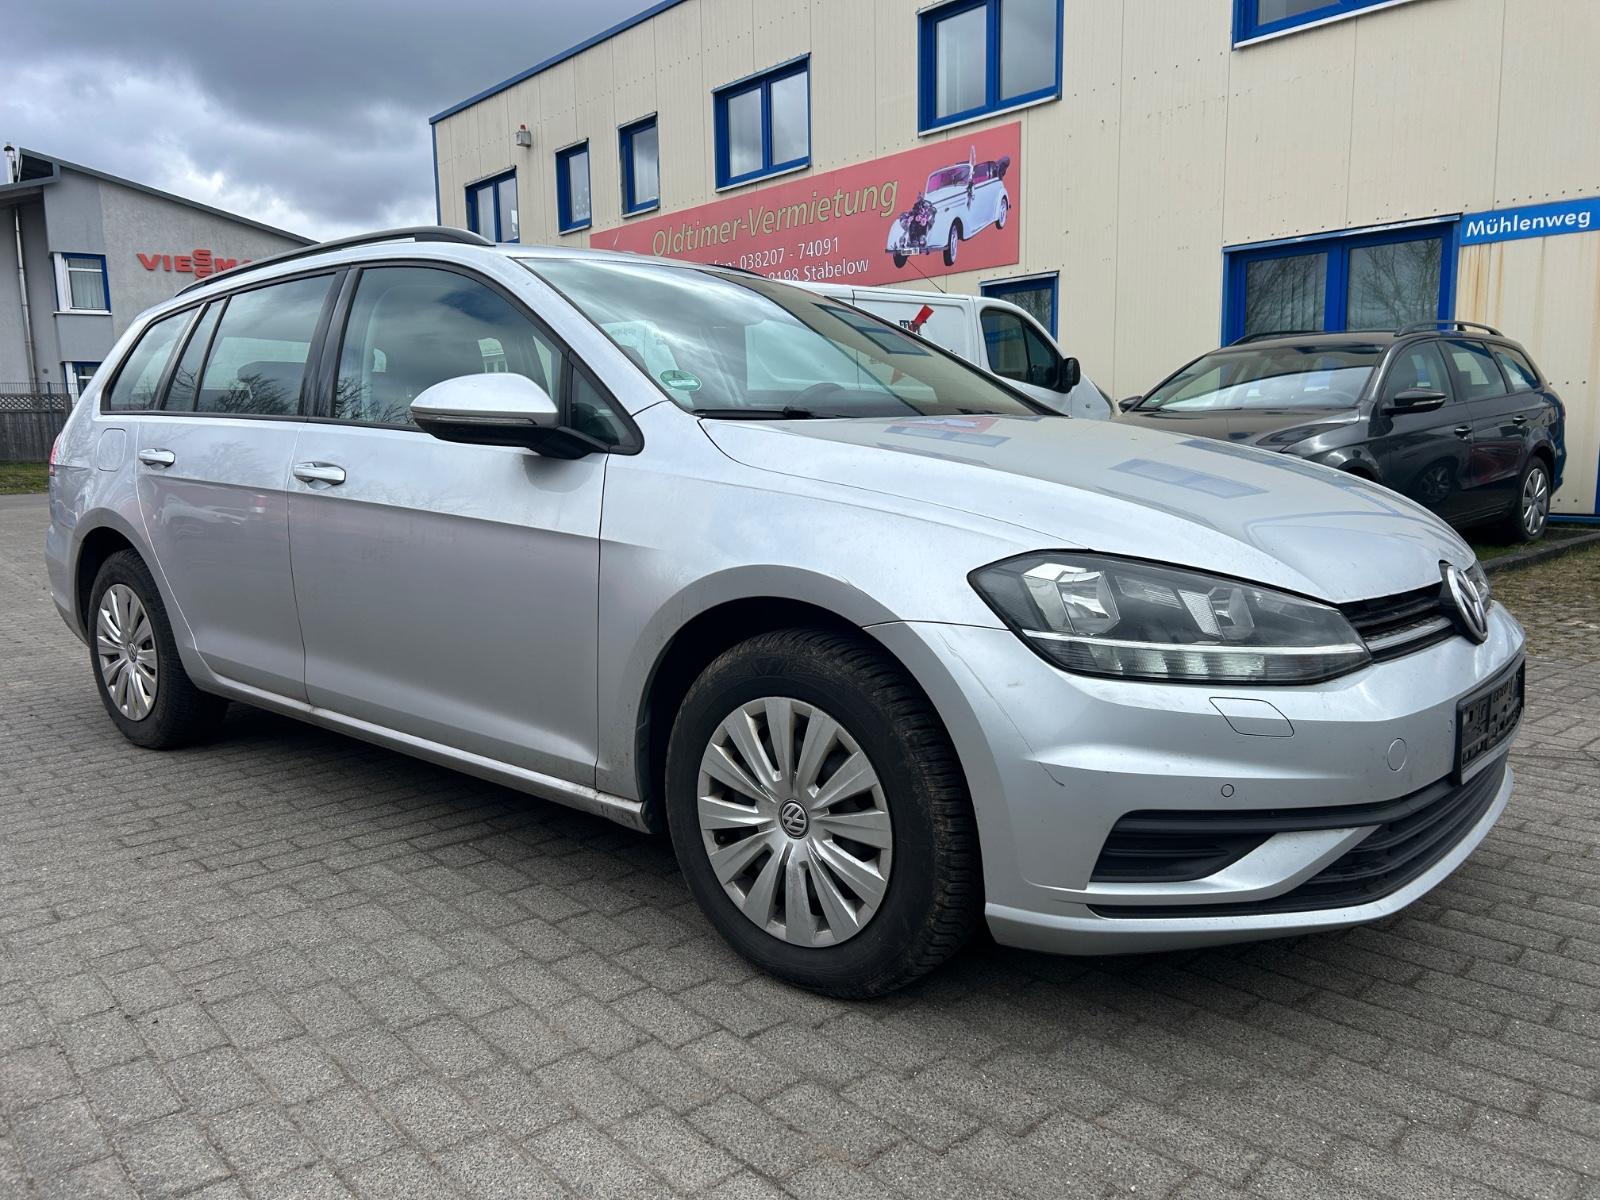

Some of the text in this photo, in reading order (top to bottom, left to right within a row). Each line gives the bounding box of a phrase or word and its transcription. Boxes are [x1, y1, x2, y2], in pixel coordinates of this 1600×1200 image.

[652, 180, 899, 257] Oldtimer-Vermietung
[1466, 211, 1591, 238] Mühlenweg
[740, 247, 785, 270] 038207
[798, 236, 839, 260] 74091
[803, 258, 870, 282] Stäbelow
